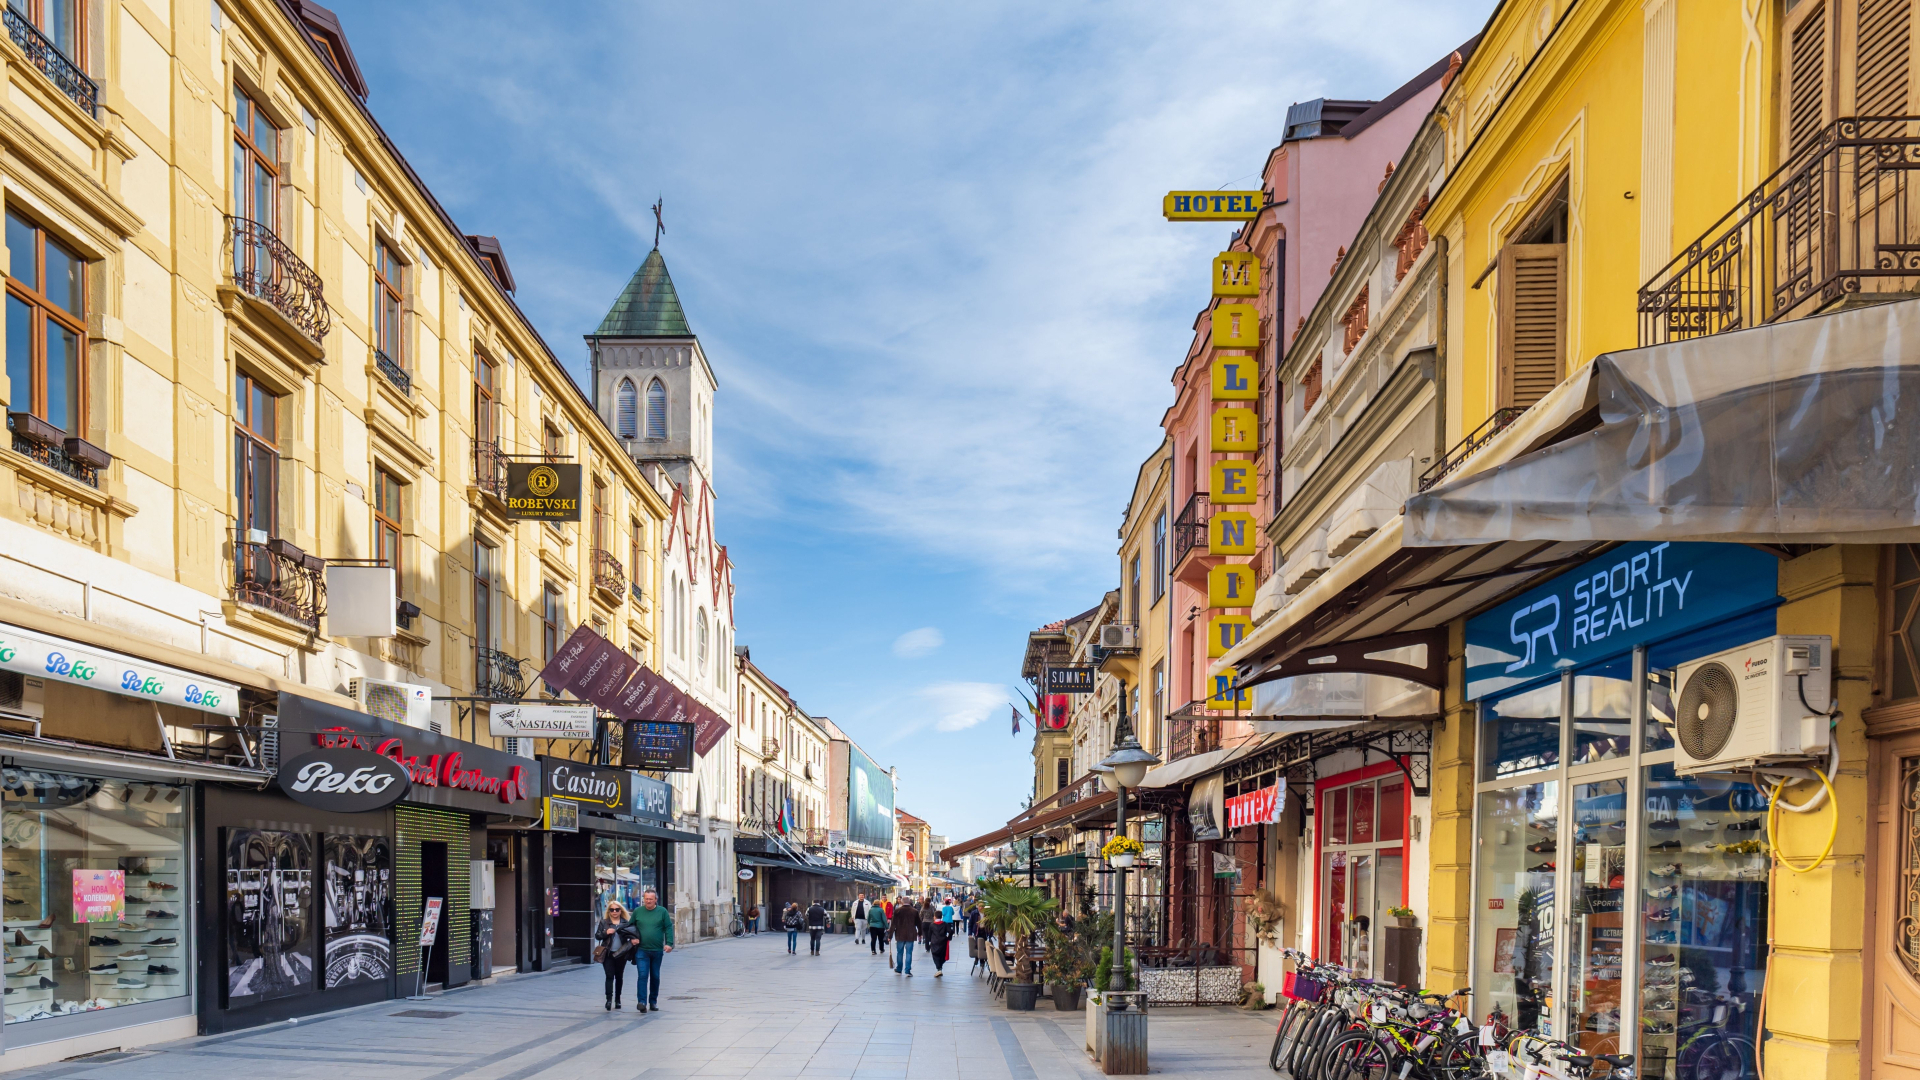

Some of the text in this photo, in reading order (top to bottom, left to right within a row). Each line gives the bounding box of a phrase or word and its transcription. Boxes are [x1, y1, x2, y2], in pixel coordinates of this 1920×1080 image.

[1173, 195, 1258, 213] HOTEL
[508, 497, 577, 510] ROBEVSKI
[1573, 541, 1670, 615] SPORT
[1572, 570, 1693, 649] REALITY
[1504, 594, 1561, 674] SR
[45, 652, 96, 681] Peko
[579, 657, 606, 688] swatch
[1751, 658, 1768, 668] FUEGO
[121, 670, 164, 696] Peko
[597, 676, 615, 697] Calvin
[611, 662, 627, 679] Klein
[623, 680, 647, 708] TISSOT
[184, 684, 221, 708] Peko
[635, 684, 660, 714] LONGINES
[291, 761, 396, 794] Peko
[443, 752, 501, 795] Casino
[552, 766, 617, 798] Casino
[646, 786, 668, 815] APEX
[91, 885, 108, 893] НОВА
[1489, 900, 1504, 908] ППА
[1537, 906, 1554, 931] 10
